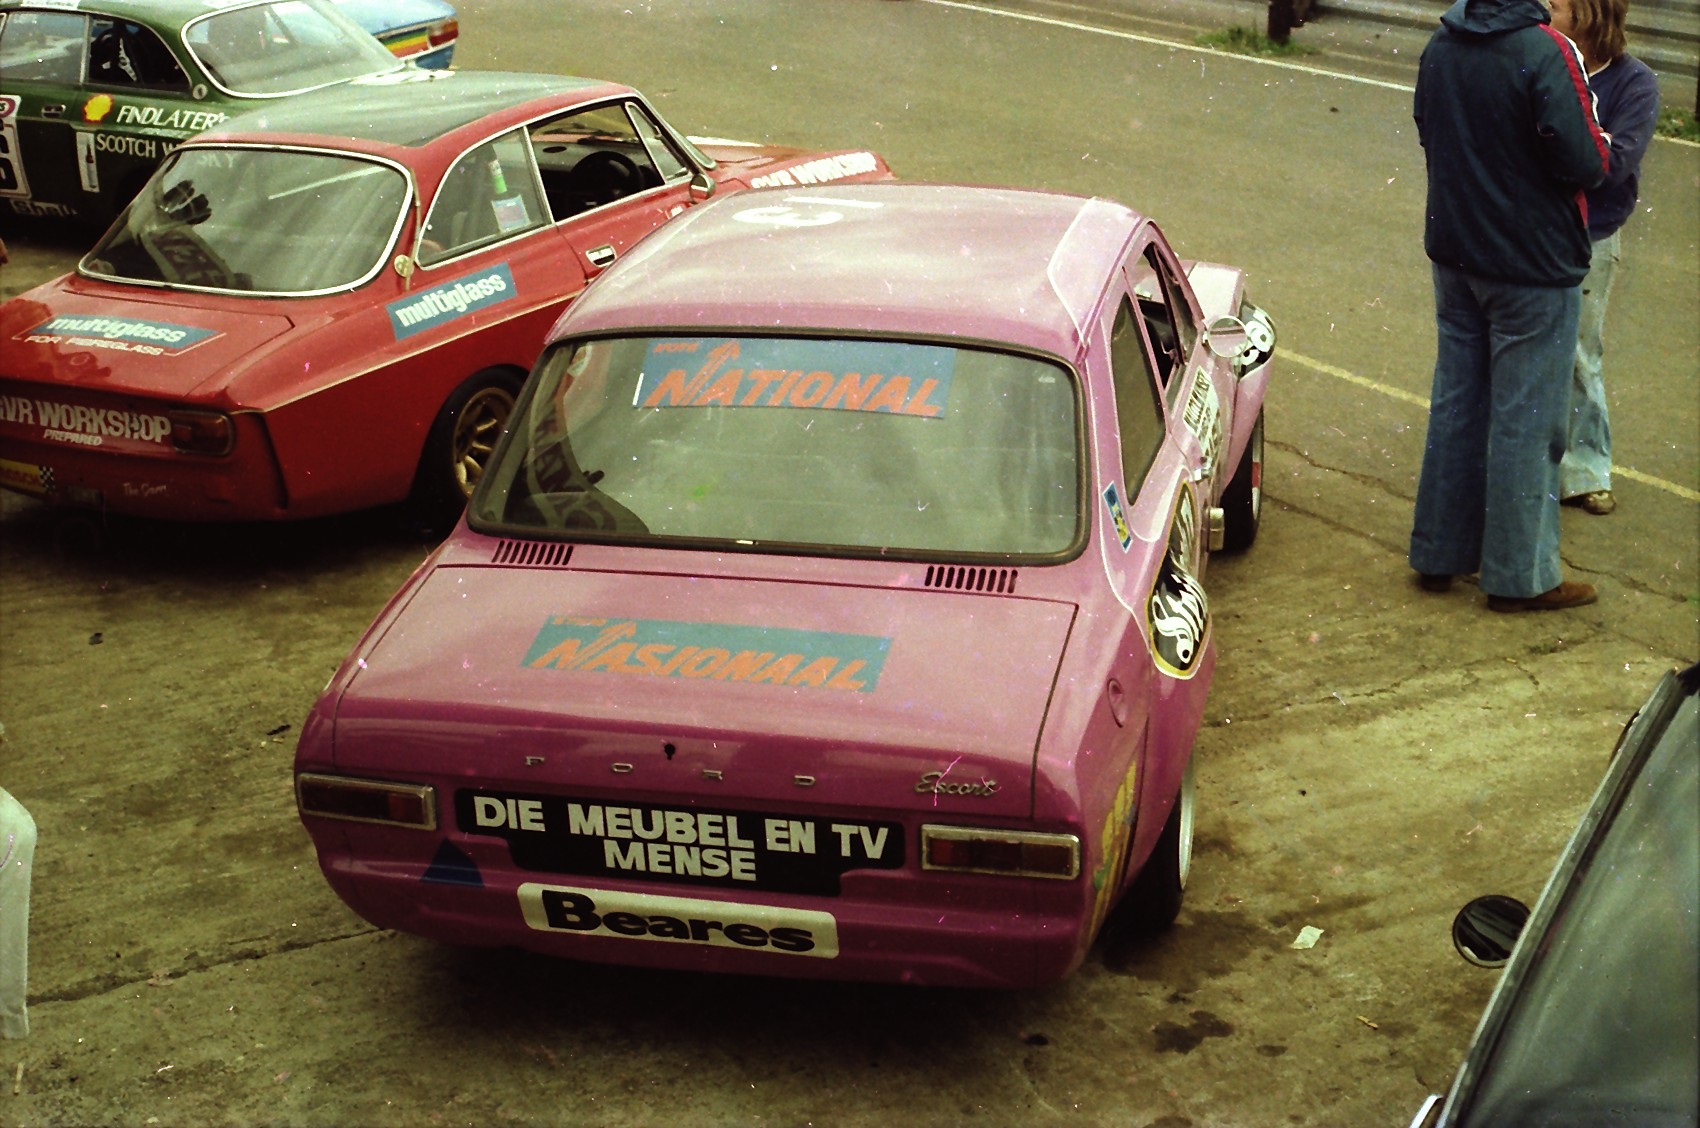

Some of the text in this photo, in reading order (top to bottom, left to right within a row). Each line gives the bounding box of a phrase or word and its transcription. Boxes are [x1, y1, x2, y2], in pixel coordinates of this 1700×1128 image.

[98, 134, 156, 158] SCOTCH
[395, 274, 507, 327] multiglass
[47, 319, 187, 343] multiglass
[643, 367, 942, 417] NATIONAL
[36, 400, 172, 443] WORKSHOP
[44, 428, 103, 446] PREPARED
[530, 639, 869, 690] NASIONAAL
[914, 771, 997, 796] Escort
[474, 797, 888, 860] DIE MEUBEL EN TV
[603, 841, 756, 881] MENSE
[541, 890, 816, 953] Beares
